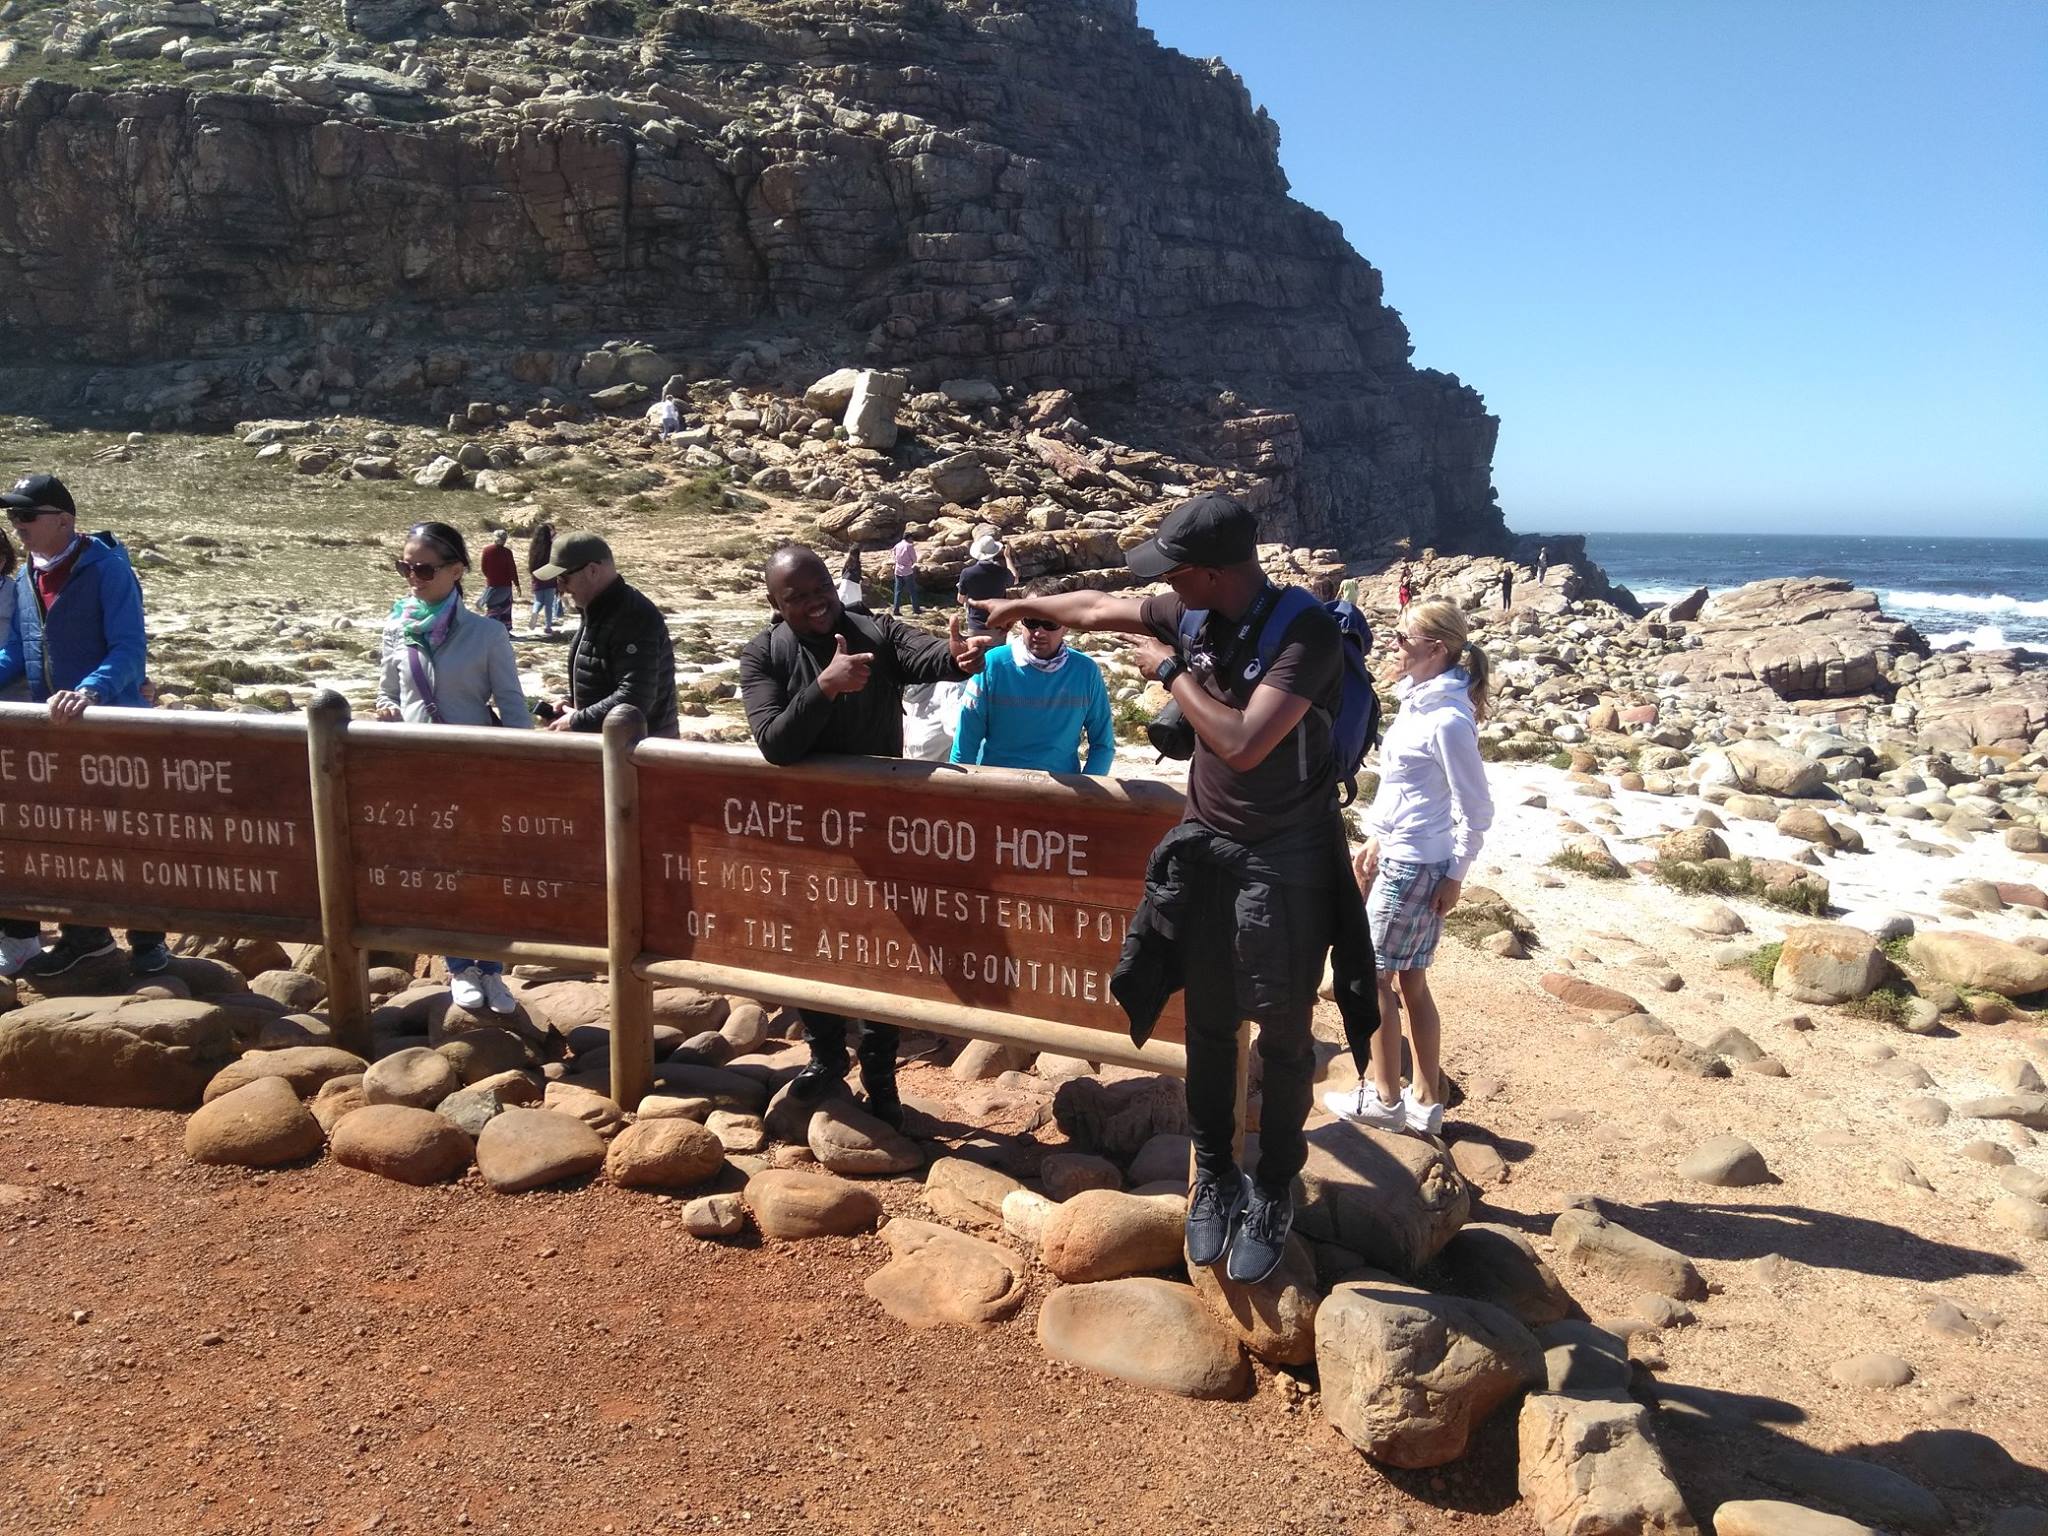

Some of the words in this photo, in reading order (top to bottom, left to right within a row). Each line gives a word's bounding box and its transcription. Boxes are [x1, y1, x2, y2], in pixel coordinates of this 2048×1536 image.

[28, 751, 59, 783] OF
[80, 754, 149, 789] GOOD
[162, 758, 233, 794] HOPE
[19, 803, 214, 841] SOUTH-WESTERN
[225, 818, 296, 847] POINT
[501, 815, 574, 836] SOUTH
[723, 797, 805, 842] CAPE
[821, 808, 867, 849] OF
[887, 816, 976, 862] GOOD
[995, 825, 1088, 876] HOPE
[24, 852, 125, 882] AFRICAN
[142, 861, 279, 894] CONTINENT
[503, 878, 563, 898] EAST
[662, 853, 708, 885] THE
[722, 861, 791, 896] MOST
[806, 875, 1055, 935] SOUTH-WESTERN
[1076, 908, 1126, 945] POI
[687, 910, 717, 939] OF
[744, 918, 793, 952] THE
[816, 928, 944, 975] AFRICAN
[963, 952, 1120, 1006] CONTINEN
